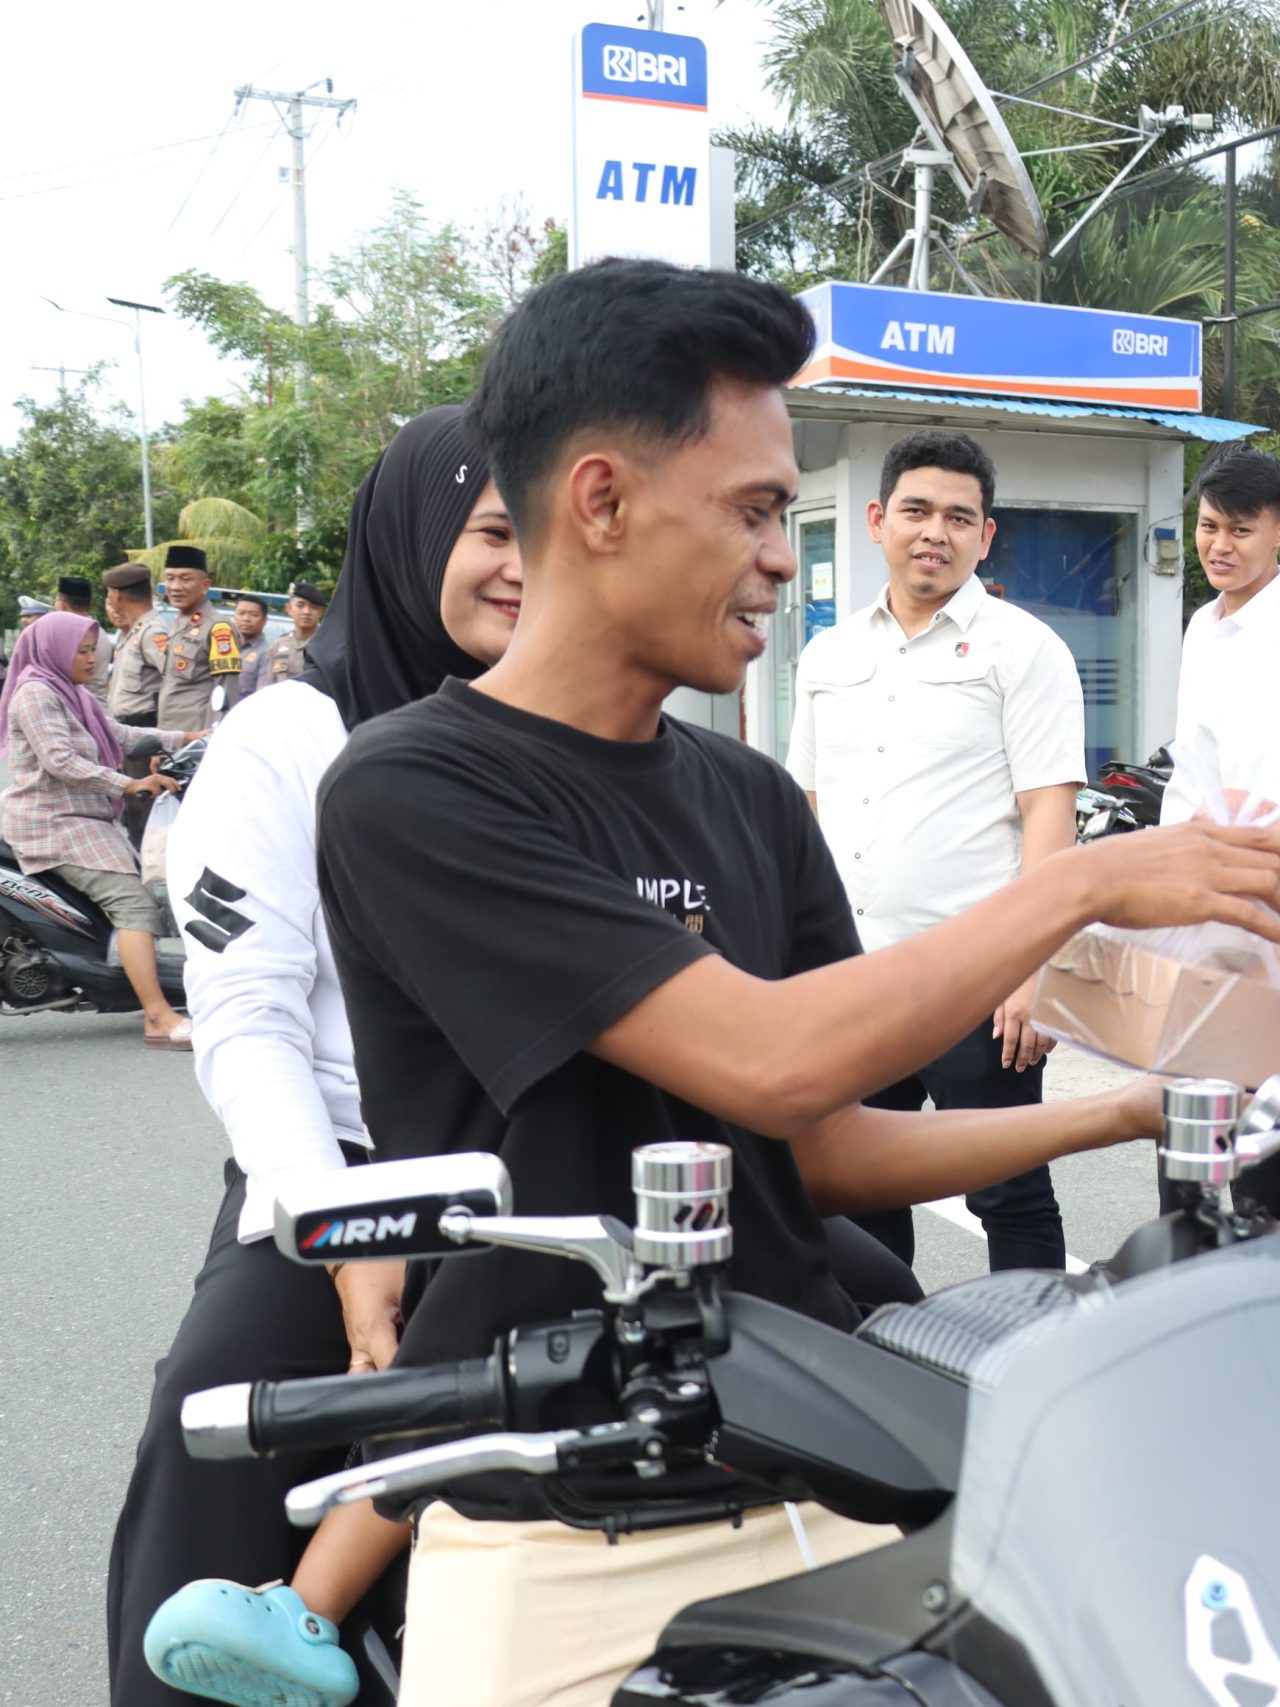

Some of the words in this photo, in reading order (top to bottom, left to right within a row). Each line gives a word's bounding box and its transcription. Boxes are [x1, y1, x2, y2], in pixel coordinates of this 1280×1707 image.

[637, 51, 687, 87] BRI
[596, 160, 697, 206] ATM
[880, 320, 955, 355] ATM
[1135, 333, 1168, 356] BRI
